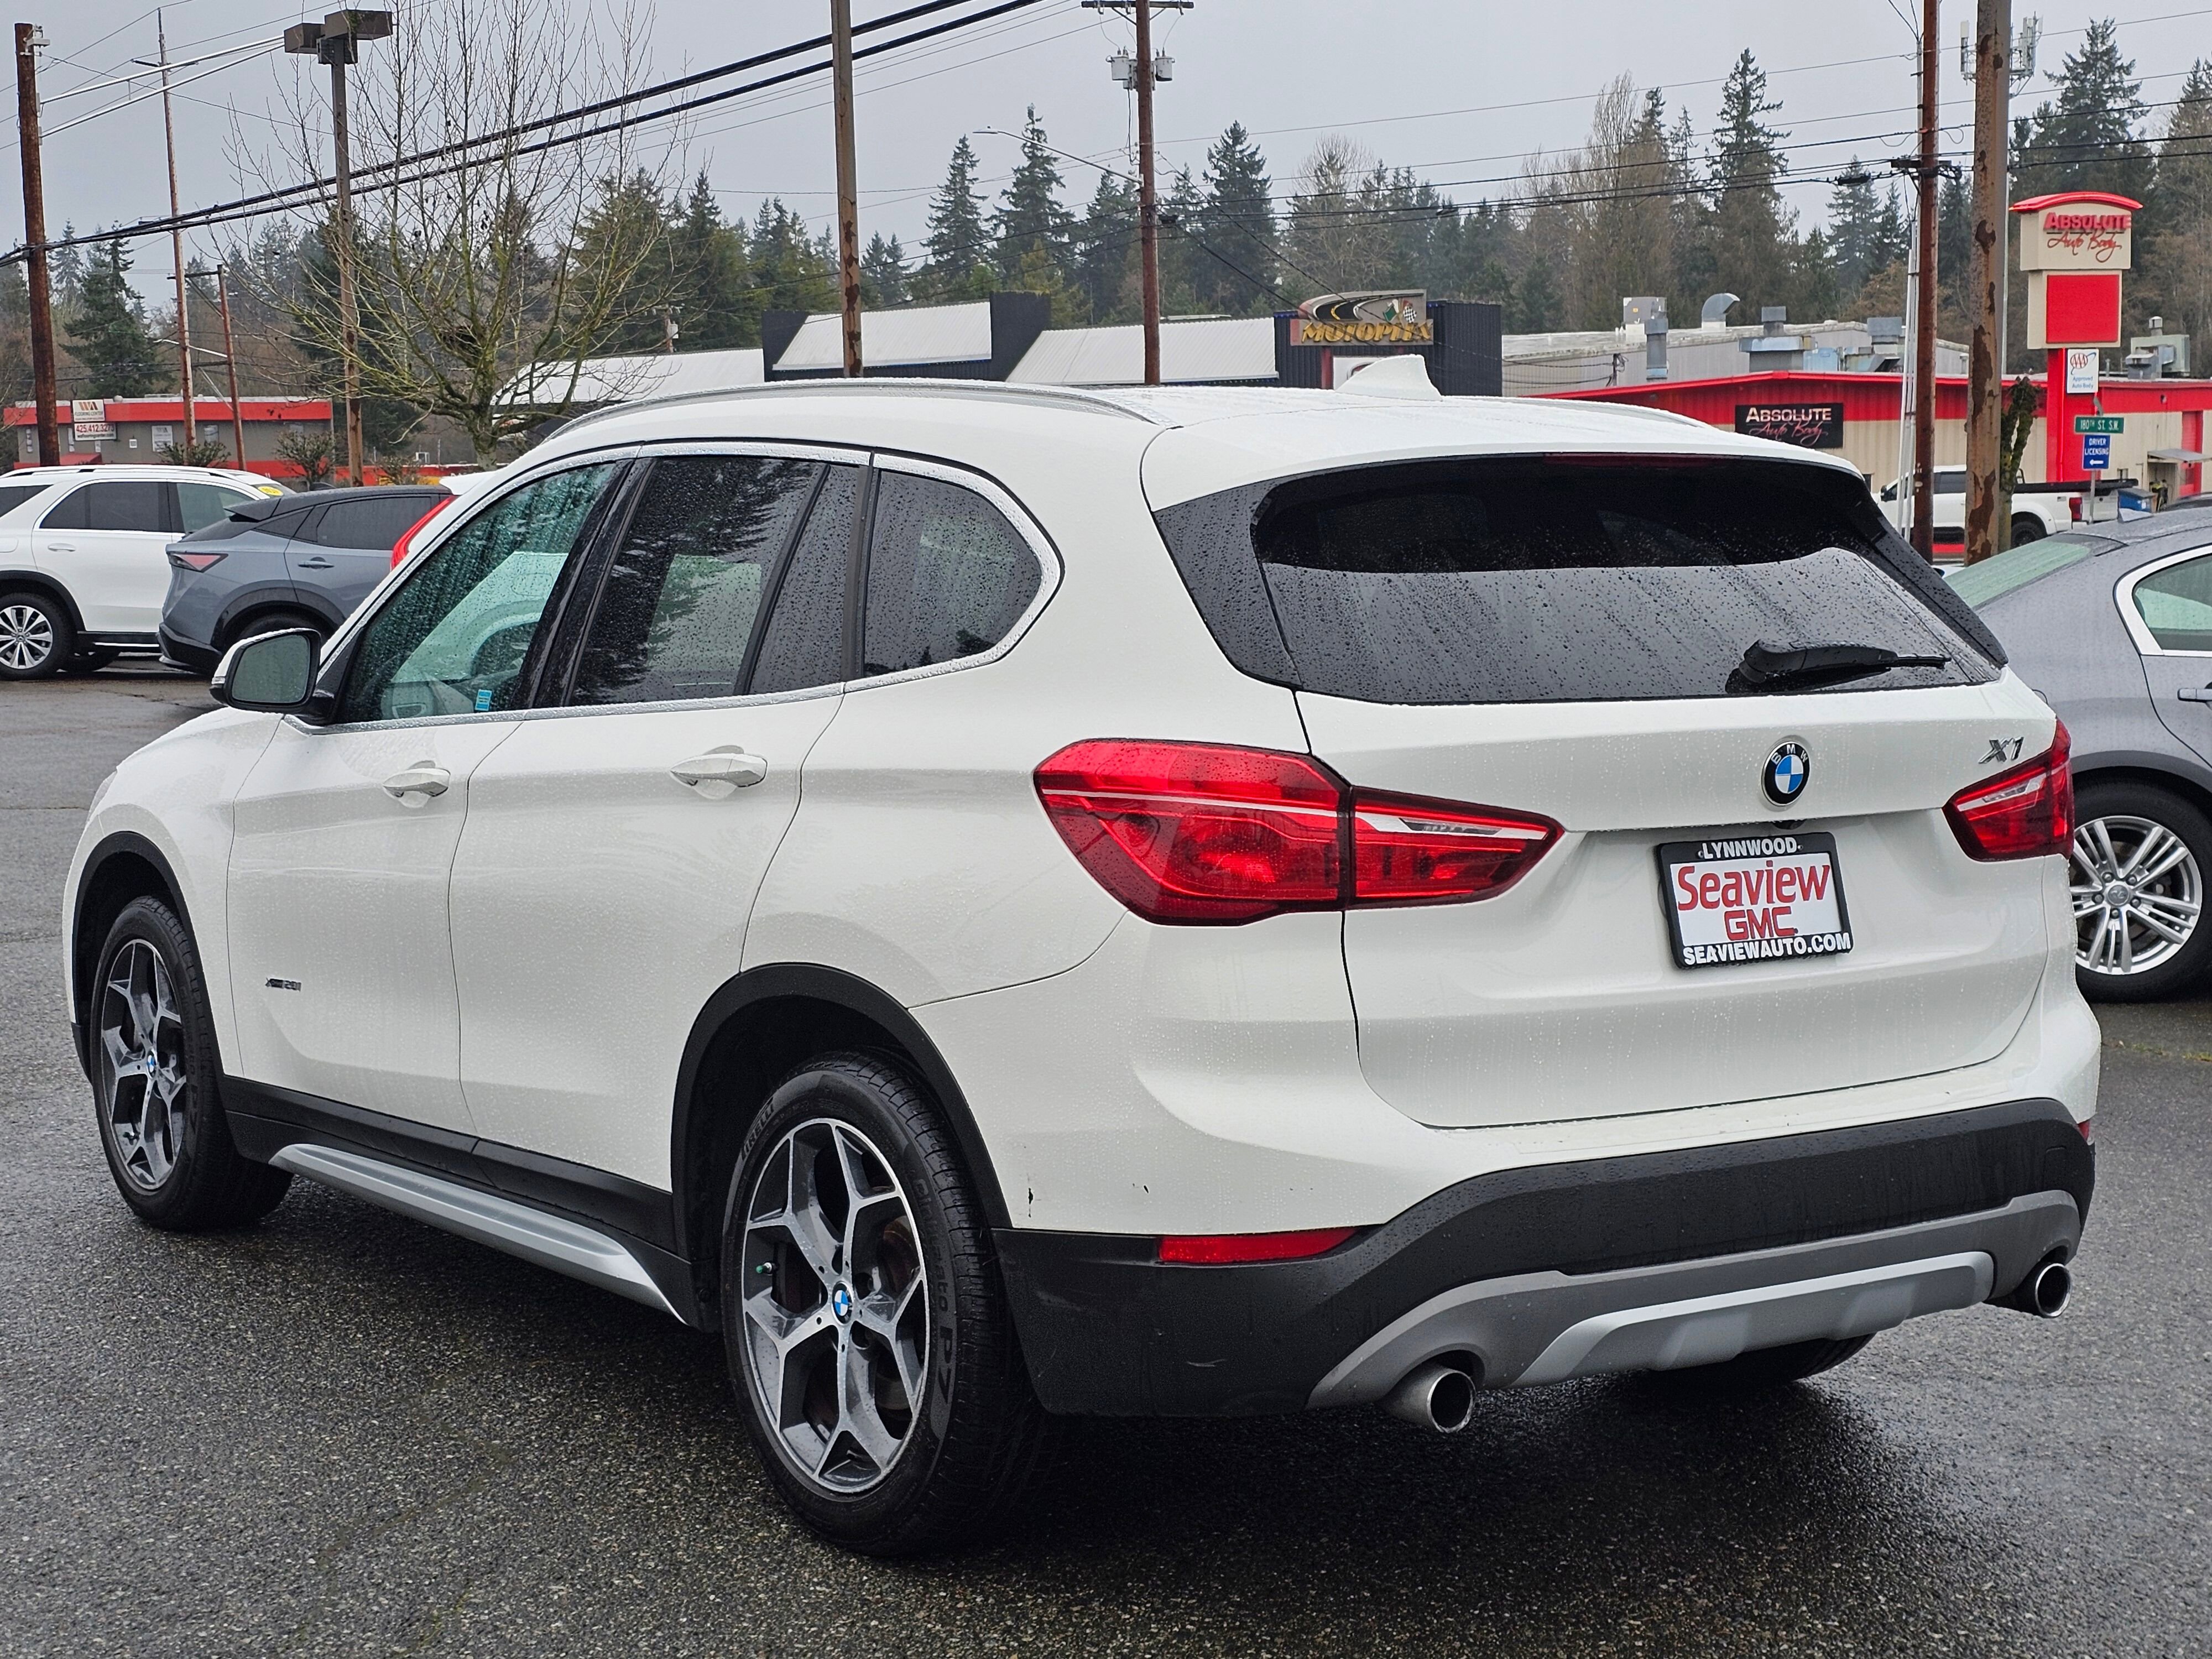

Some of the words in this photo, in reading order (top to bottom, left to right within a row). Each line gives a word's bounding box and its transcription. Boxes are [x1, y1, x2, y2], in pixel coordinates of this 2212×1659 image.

[2044, 212, 2131, 230] ABSOLUTE
[2047, 230, 2085, 255] Auto
[2088, 228, 2122, 263] Body
[1746, 407, 1832, 422] ABSOLUTE
[1749, 422, 1789, 441] Auto
[1792, 419, 1828, 447] Body
[1771, 744, 1808, 765] BMW
[1978, 737, 2024, 764] X1
[1702, 837, 1797, 859] LYNNWOOD
[1678, 860, 1831, 911] Seaview
[1683, 932, 1851, 966] SEAVIEWAUTO.COM
